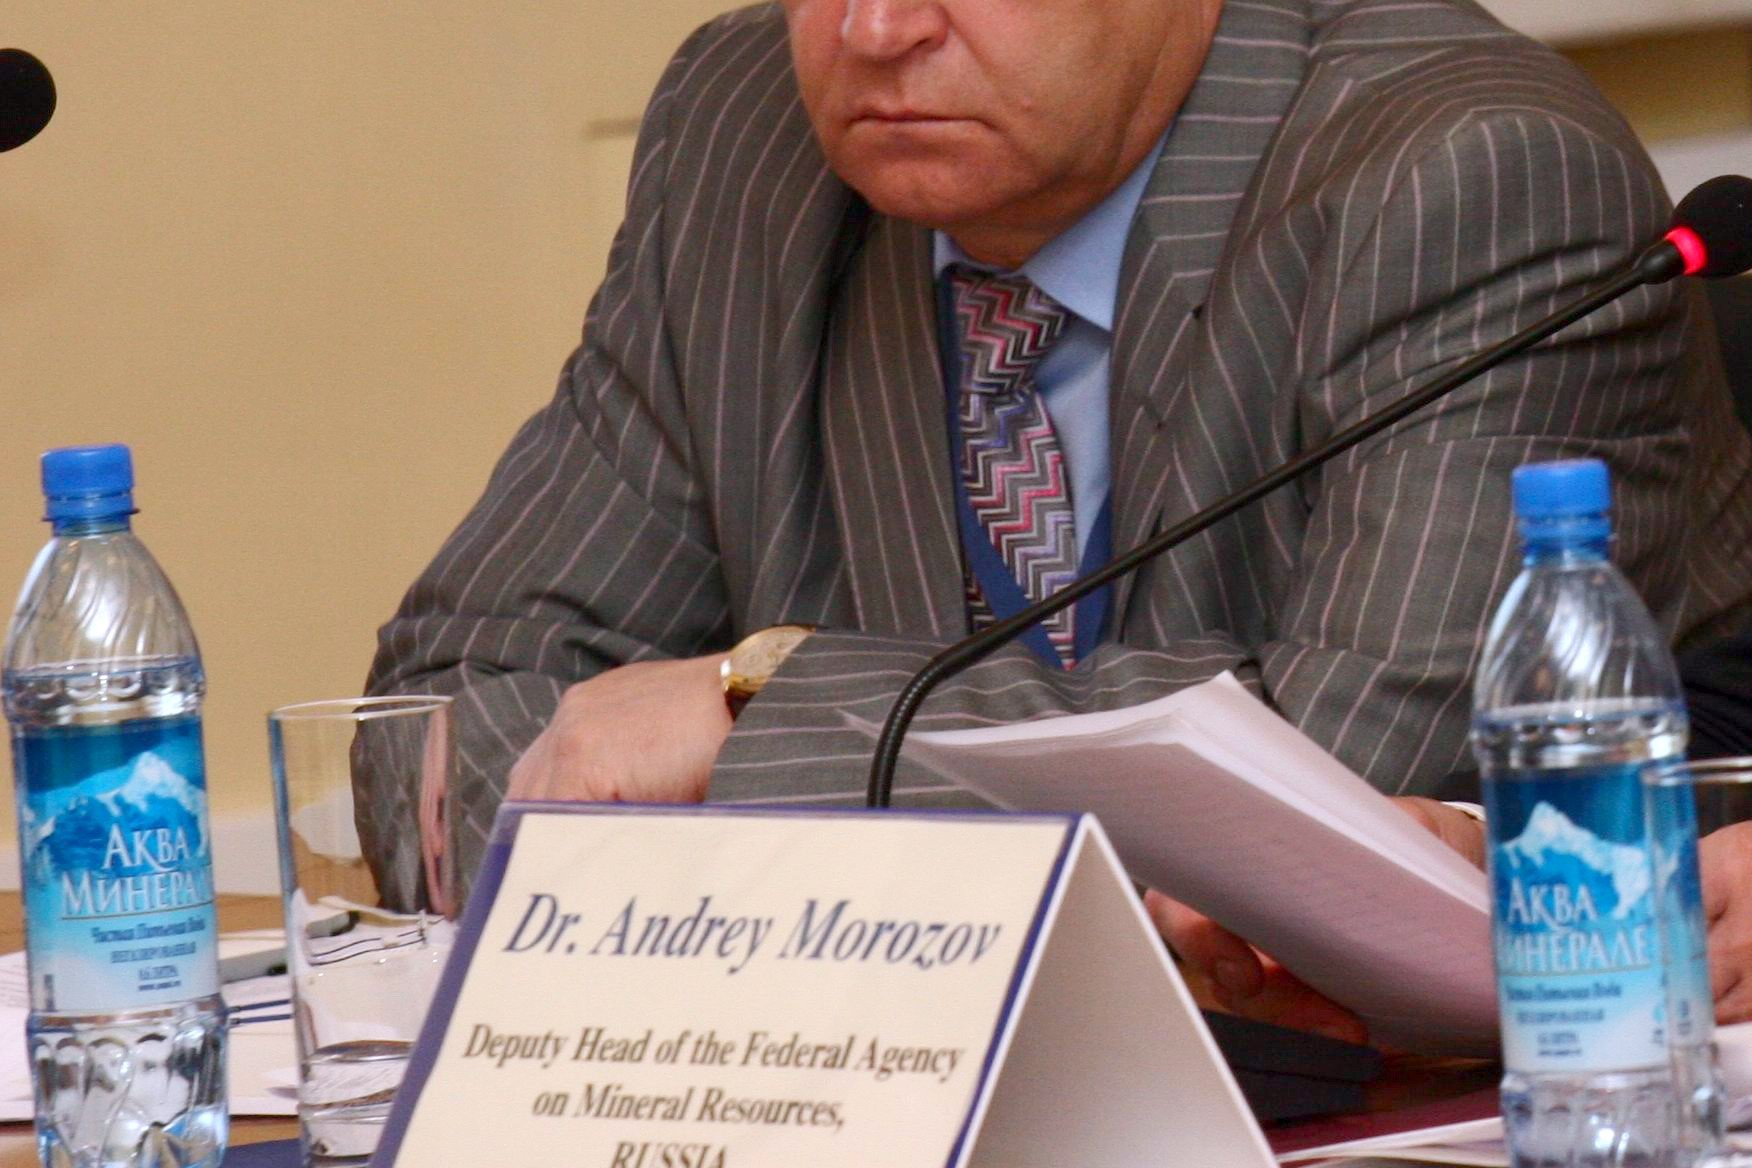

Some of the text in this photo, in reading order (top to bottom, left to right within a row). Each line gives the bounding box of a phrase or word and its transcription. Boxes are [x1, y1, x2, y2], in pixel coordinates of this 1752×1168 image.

[102, 823, 190, 872] АКВА
[61, 865, 213, 916] МИНЕРА
[1508, 877, 1598, 934] АКВА
[502, 892, 1003, 975] Dr. Andrey Morozov
[463, 1023, 968, 1081] Deputy Head of the Federal Agency
[532, 1082, 847, 1134] on Mineral Resources,
[609, 1140, 728, 1168] RUSSIA
